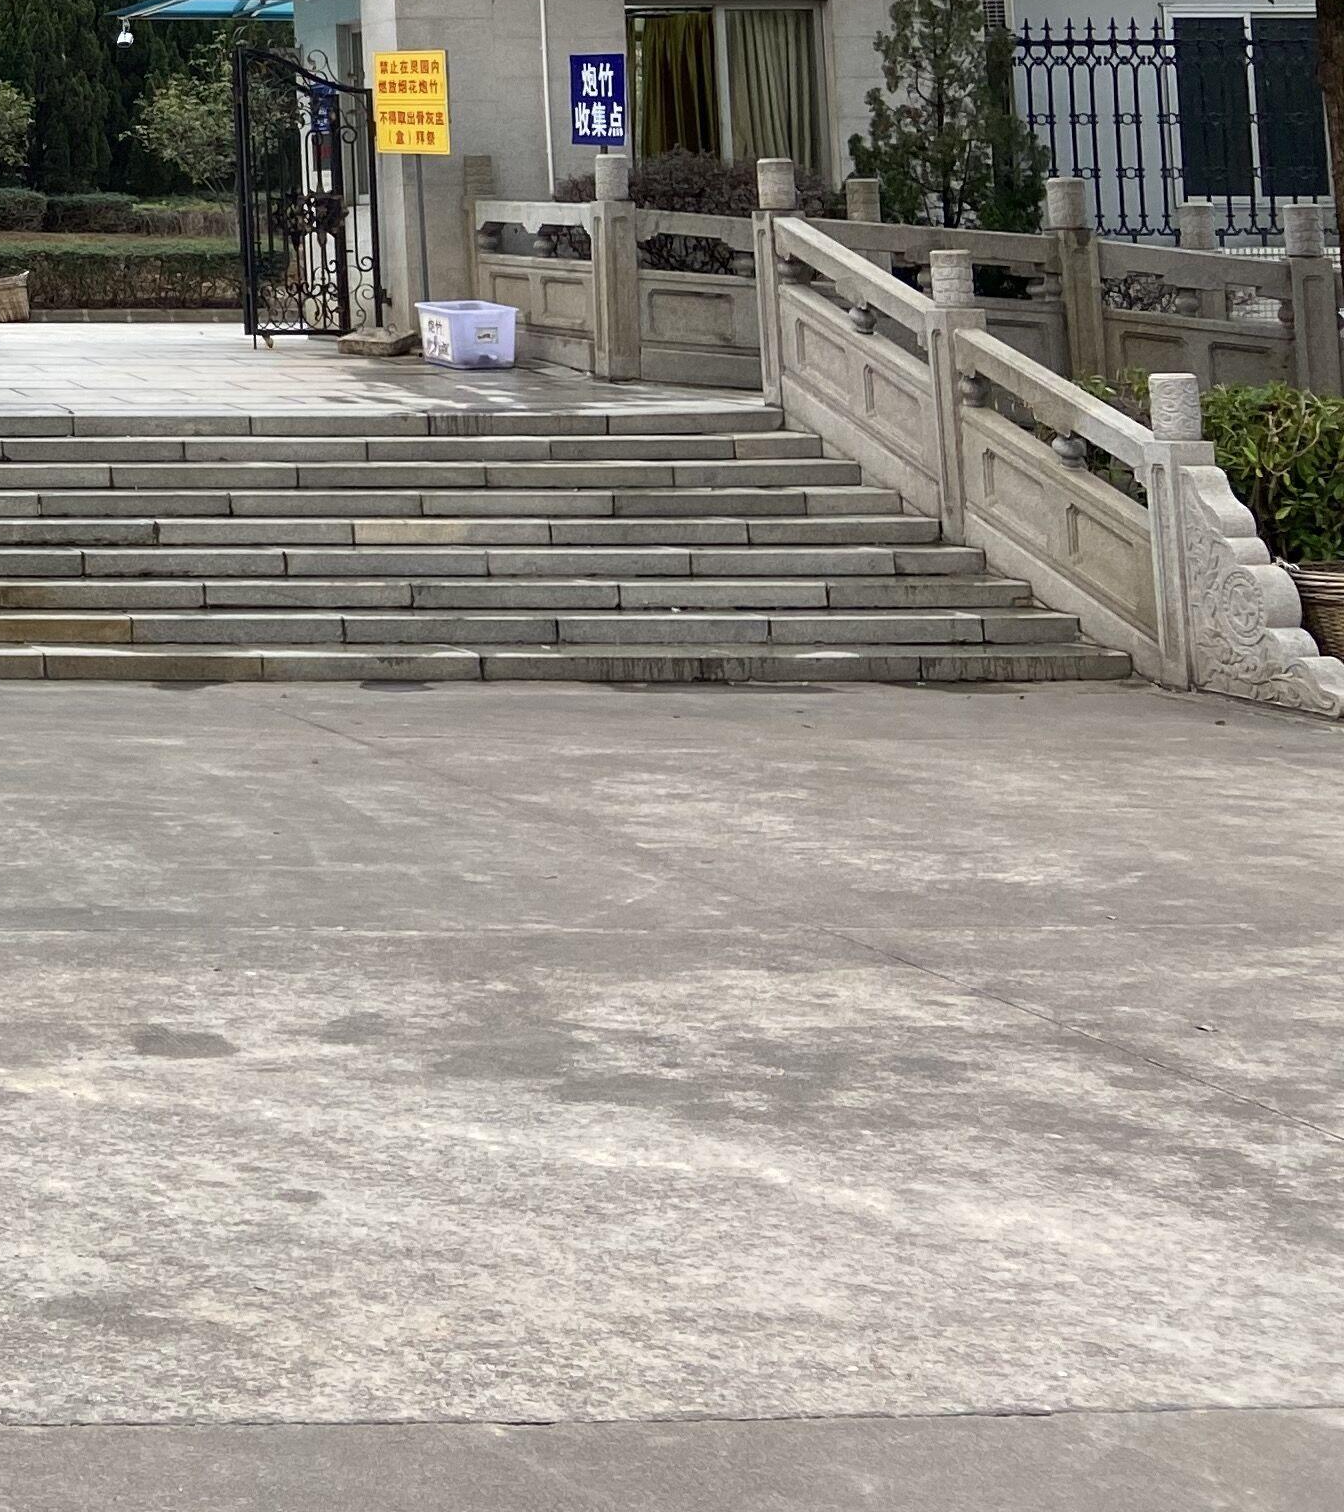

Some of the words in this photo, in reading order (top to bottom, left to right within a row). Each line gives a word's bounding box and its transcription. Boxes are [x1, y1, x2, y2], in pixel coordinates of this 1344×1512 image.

[581, 63, 614, 98] 炮竹
[575, 101, 623, 137] 收集点
